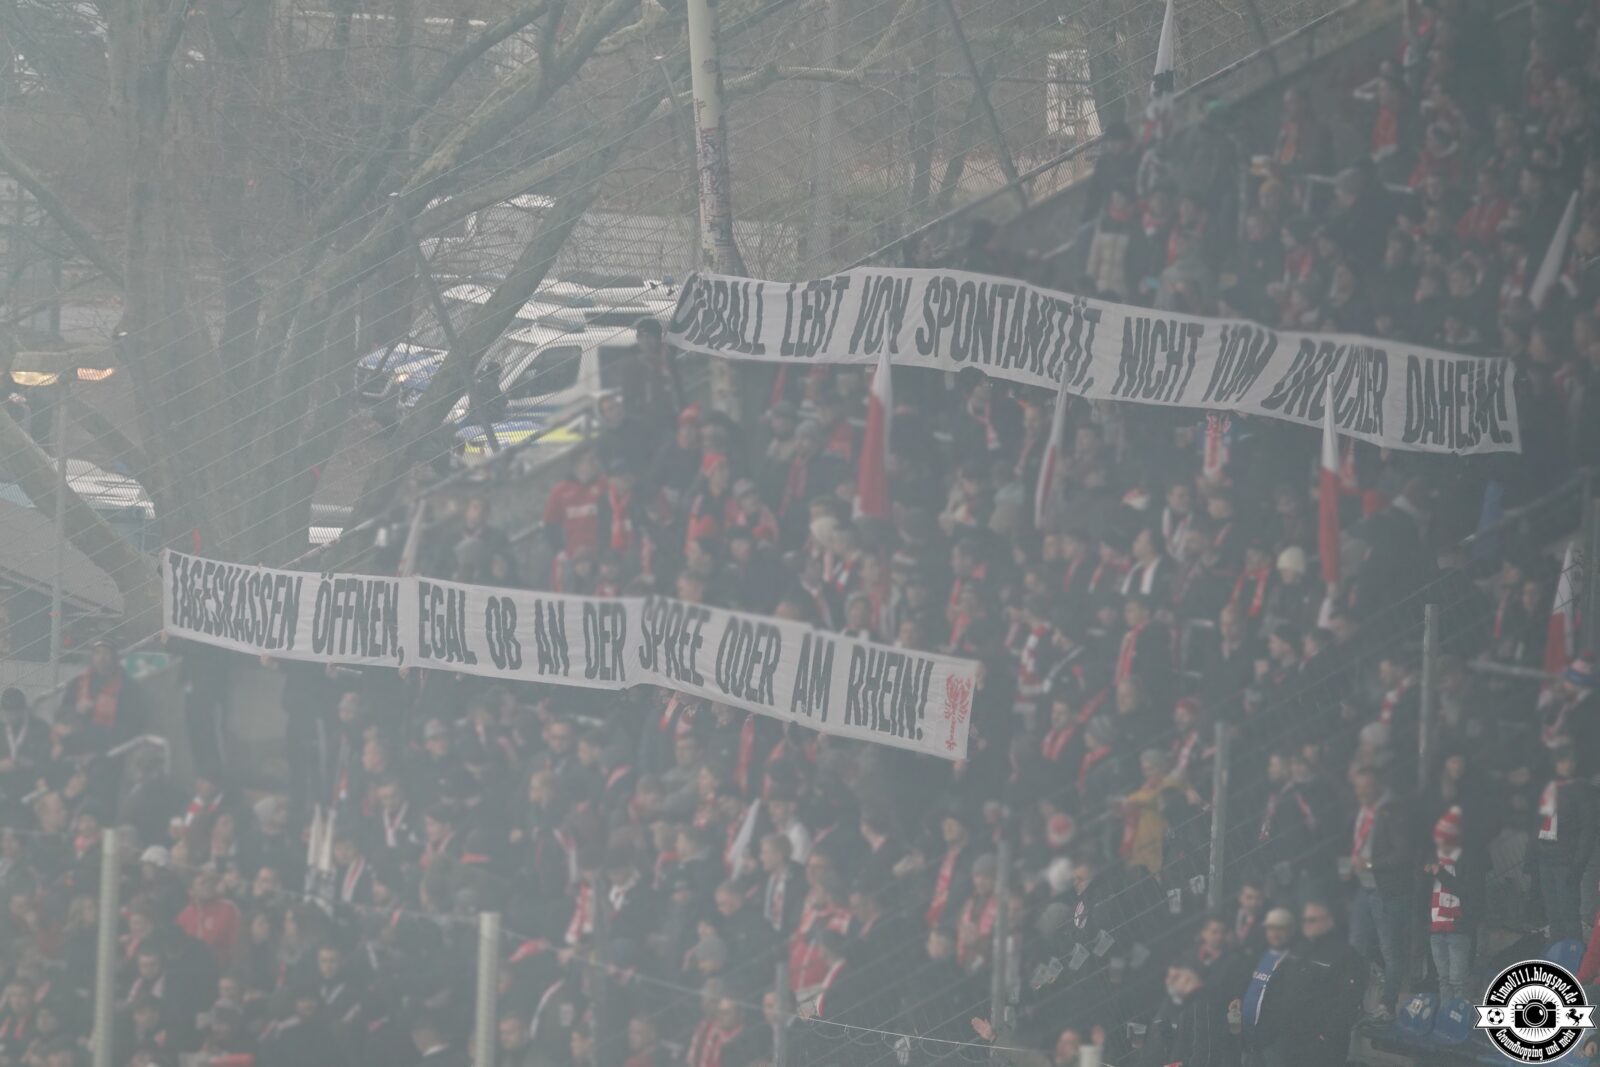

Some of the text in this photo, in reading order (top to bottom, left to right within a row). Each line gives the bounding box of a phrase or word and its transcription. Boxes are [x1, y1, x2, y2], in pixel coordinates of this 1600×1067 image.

[780, 275, 850, 358] LEBT
[849, 275, 912, 356] VON
[1111, 316, 1204, 403] NICHT
[1201, 319, 1279, 403] VOM
[169, 552, 934, 741] TAGESKASSEN ÖFFNEN, EGAL OB AN DER SPREE ODER AM RHEIN!
